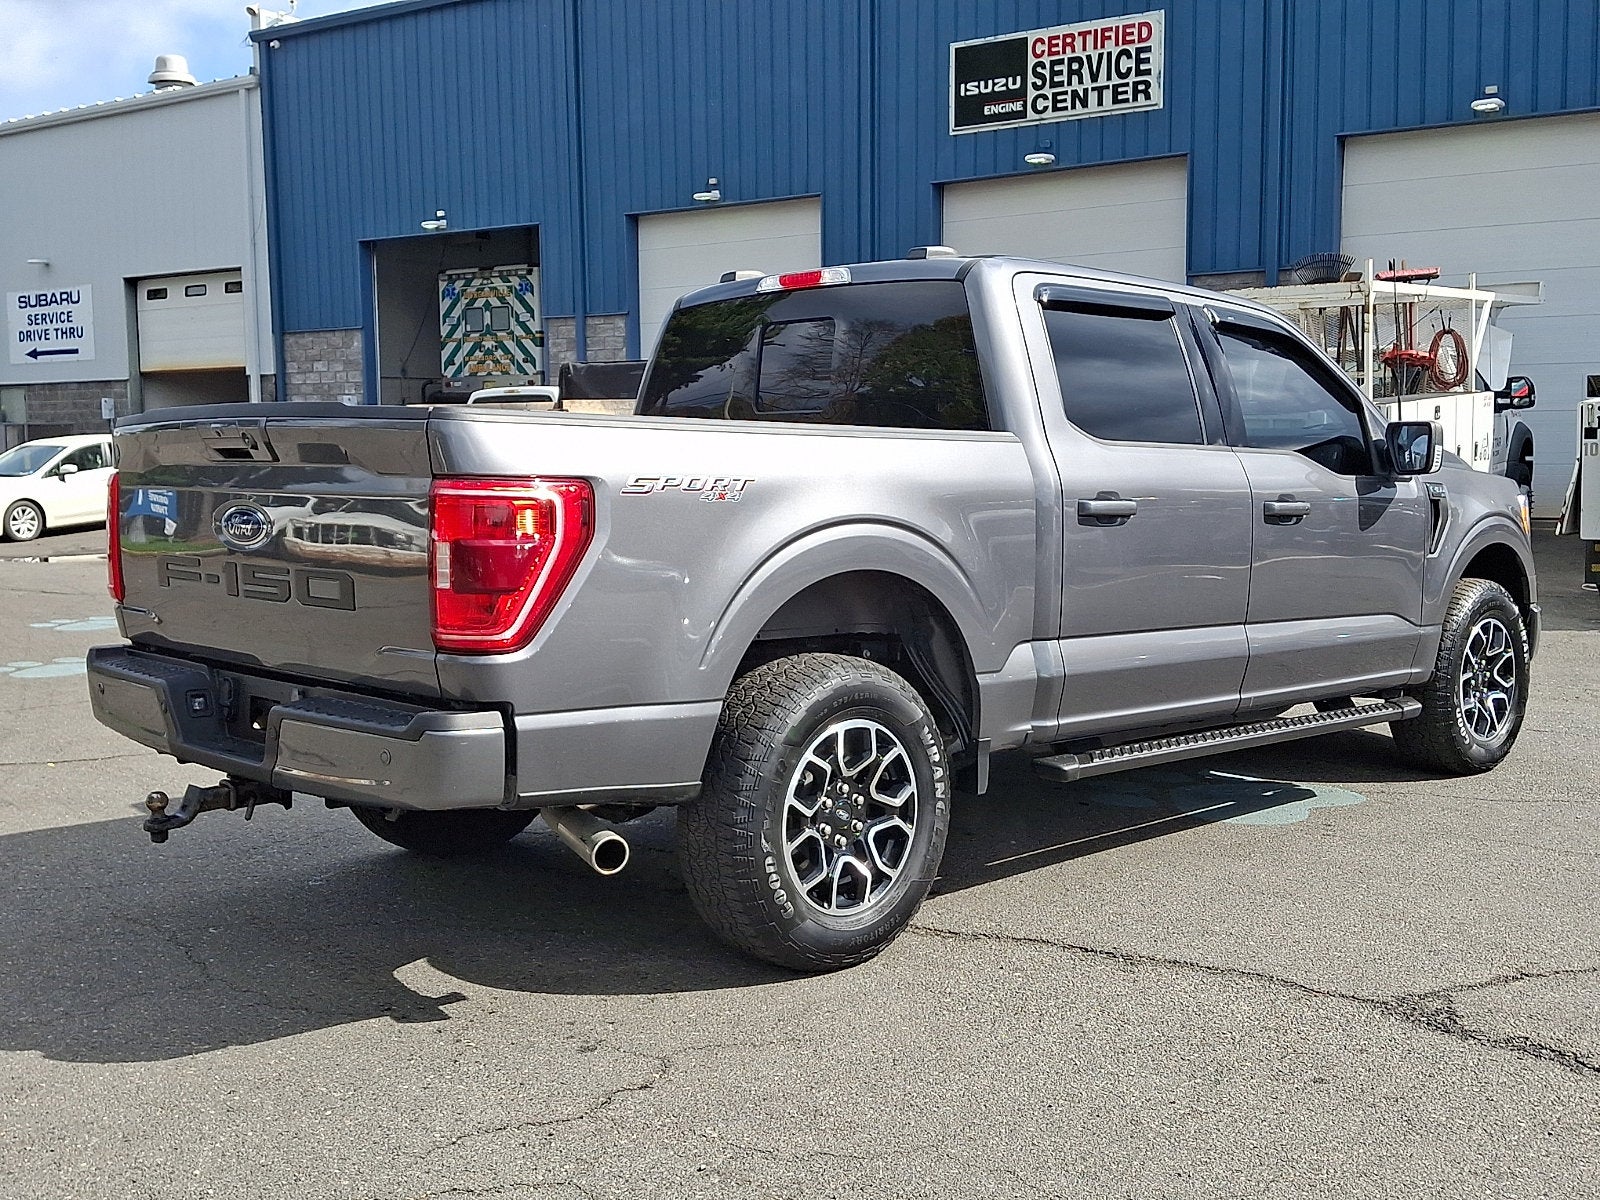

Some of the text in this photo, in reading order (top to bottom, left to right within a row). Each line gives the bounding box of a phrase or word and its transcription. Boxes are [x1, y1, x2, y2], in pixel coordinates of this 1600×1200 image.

[1031, 21, 1153, 59] CERTIFIED
[1031, 46, 1153, 92] SERVICE
[960, 75, 1022, 97] ISUZU
[1031, 79, 1152, 115] CENTER
[983, 101, 1024, 116] ENGINE
[18, 289, 81, 309] SUBARU
[27, 311, 73, 326] SERVICE
[18, 326, 84, 342] DRIVE THRU
[620, 475, 756, 496] SPORT
[227, 513, 254, 536] Ford
[157, 555, 357, 611] F-150
